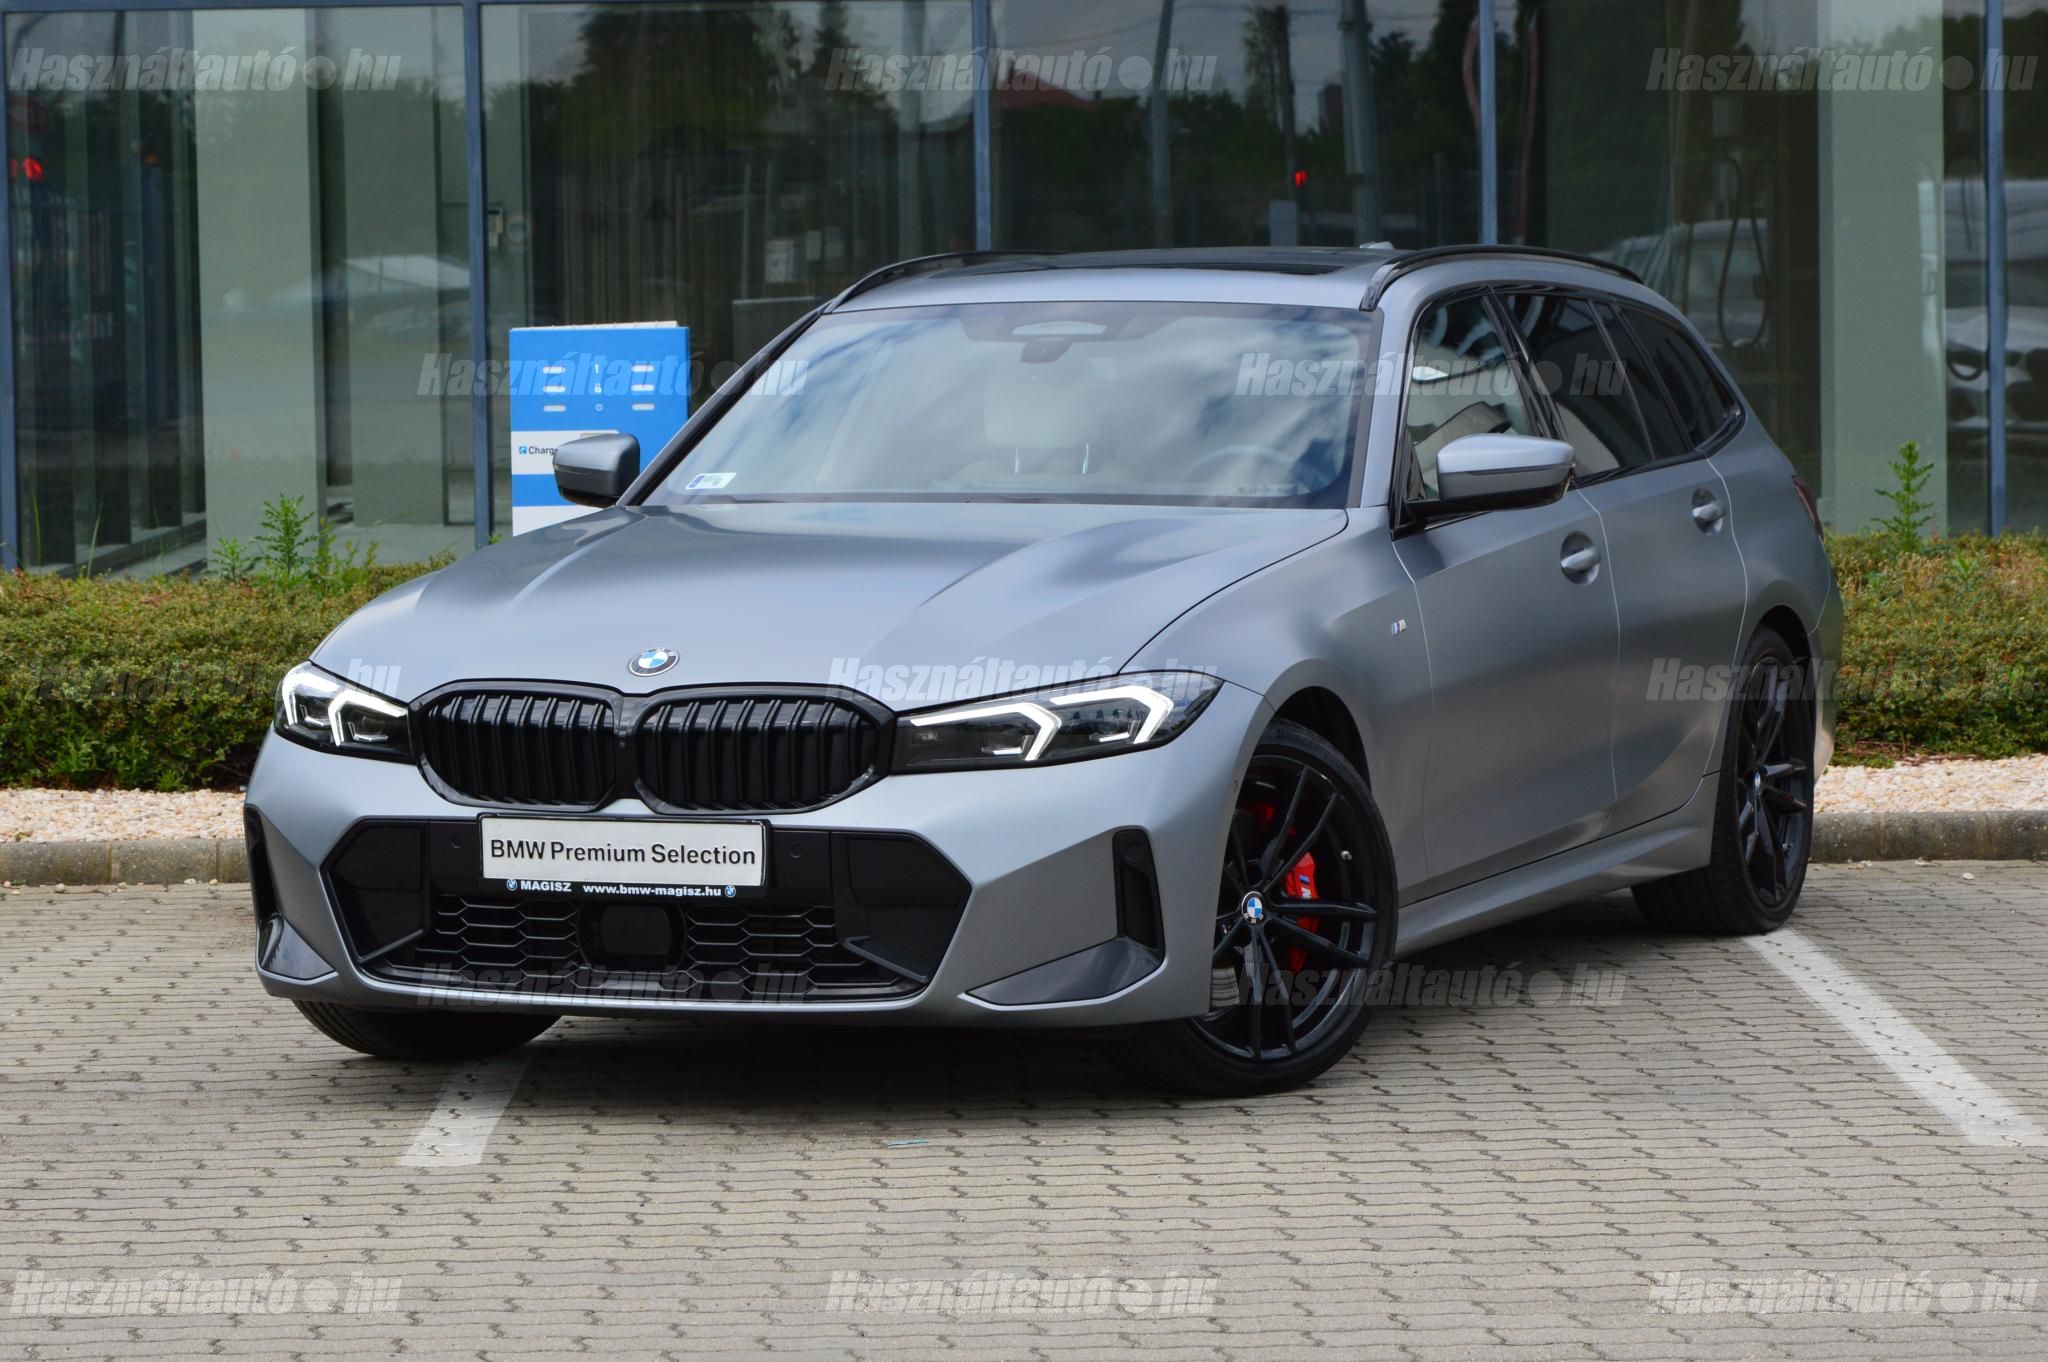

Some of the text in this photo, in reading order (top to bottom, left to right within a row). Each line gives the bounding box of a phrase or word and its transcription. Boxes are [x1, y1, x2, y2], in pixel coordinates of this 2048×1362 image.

[490, 839, 756, 865] BMW Premium Selection
[520, 880, 722, 897] MAGISZ www.bmw-magisz.hu
